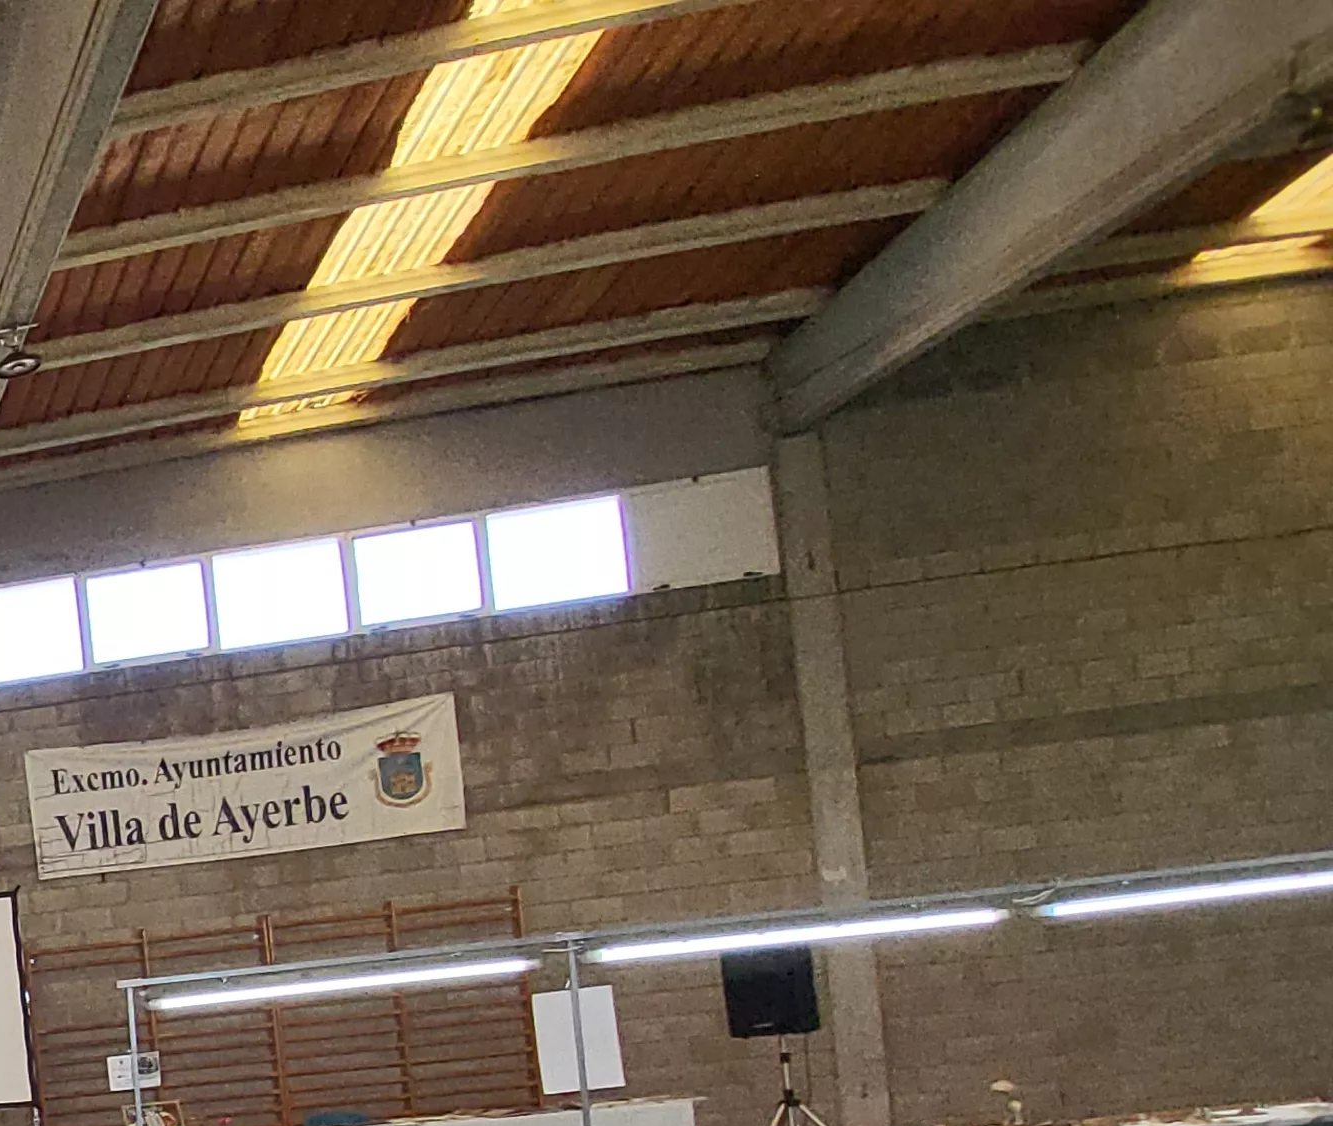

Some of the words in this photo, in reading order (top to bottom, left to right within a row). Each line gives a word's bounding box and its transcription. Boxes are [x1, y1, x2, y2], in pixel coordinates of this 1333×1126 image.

[52, 765, 149, 796] Excmo.
[154, 738, 342, 789] Ayuntamiento
[54, 807, 145, 853] Villa
[158, 800, 203, 843] de
[211, 783, 351, 845] Ayerbe
